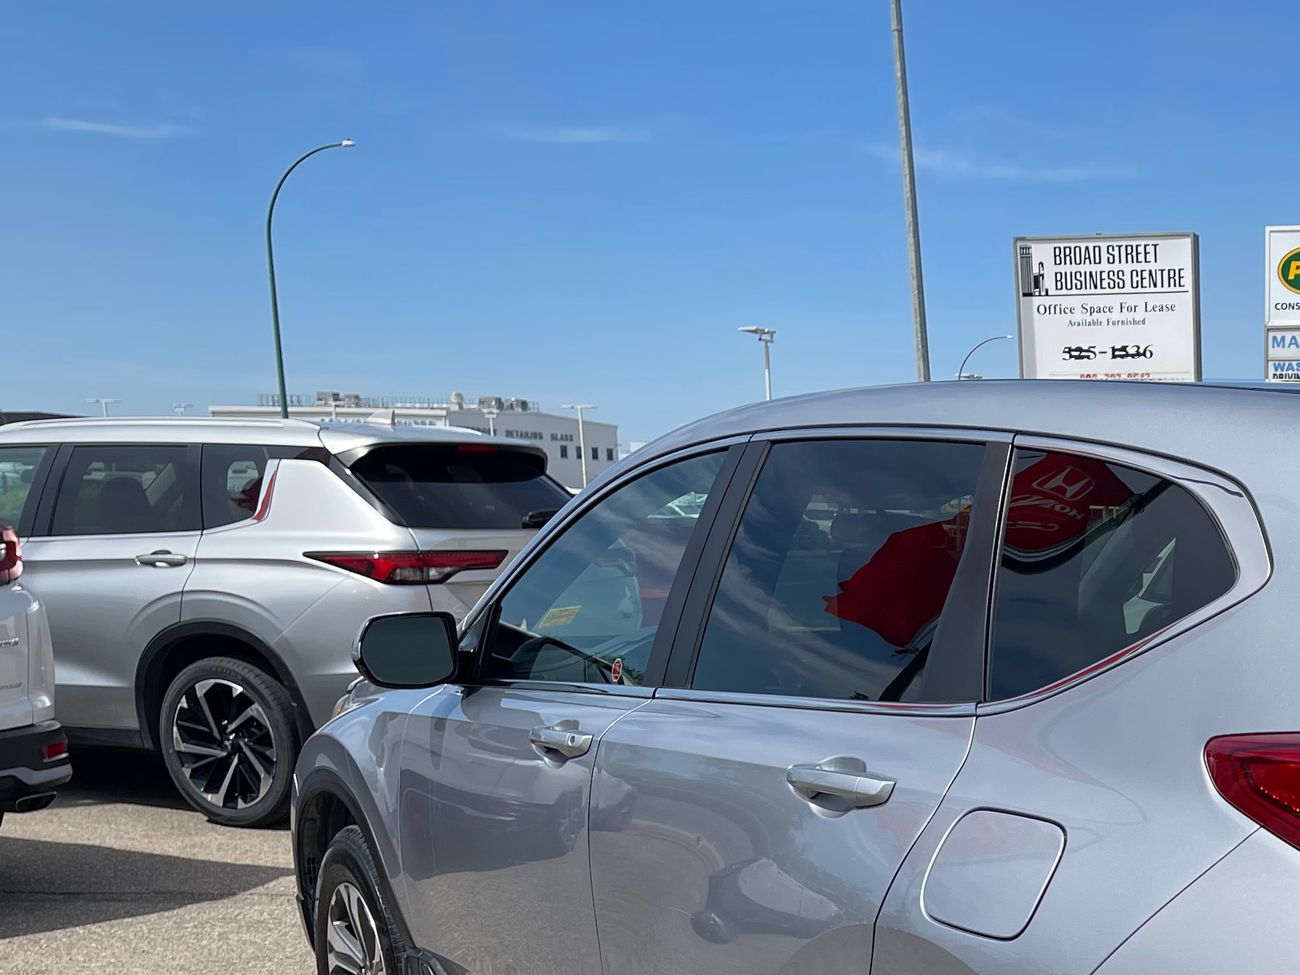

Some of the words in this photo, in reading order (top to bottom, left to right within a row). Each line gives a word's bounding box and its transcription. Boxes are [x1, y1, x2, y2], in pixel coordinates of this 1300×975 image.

[1053, 245, 1101, 266] BROAD
[1106, 243, 1160, 265] STREET
[1054, 270, 1126, 291] BUSINESS
[1130, 268, 1185, 289] CENTRE
[1036, 303, 1076, 316] Office
[1080, 303, 1114, 317] Space
[1119, 302, 1139, 313] For
[1144, 301, 1176, 313] Lease
[1067, 318, 1103, 328] Available
[1106, 317, 1146, 326] Furnished
